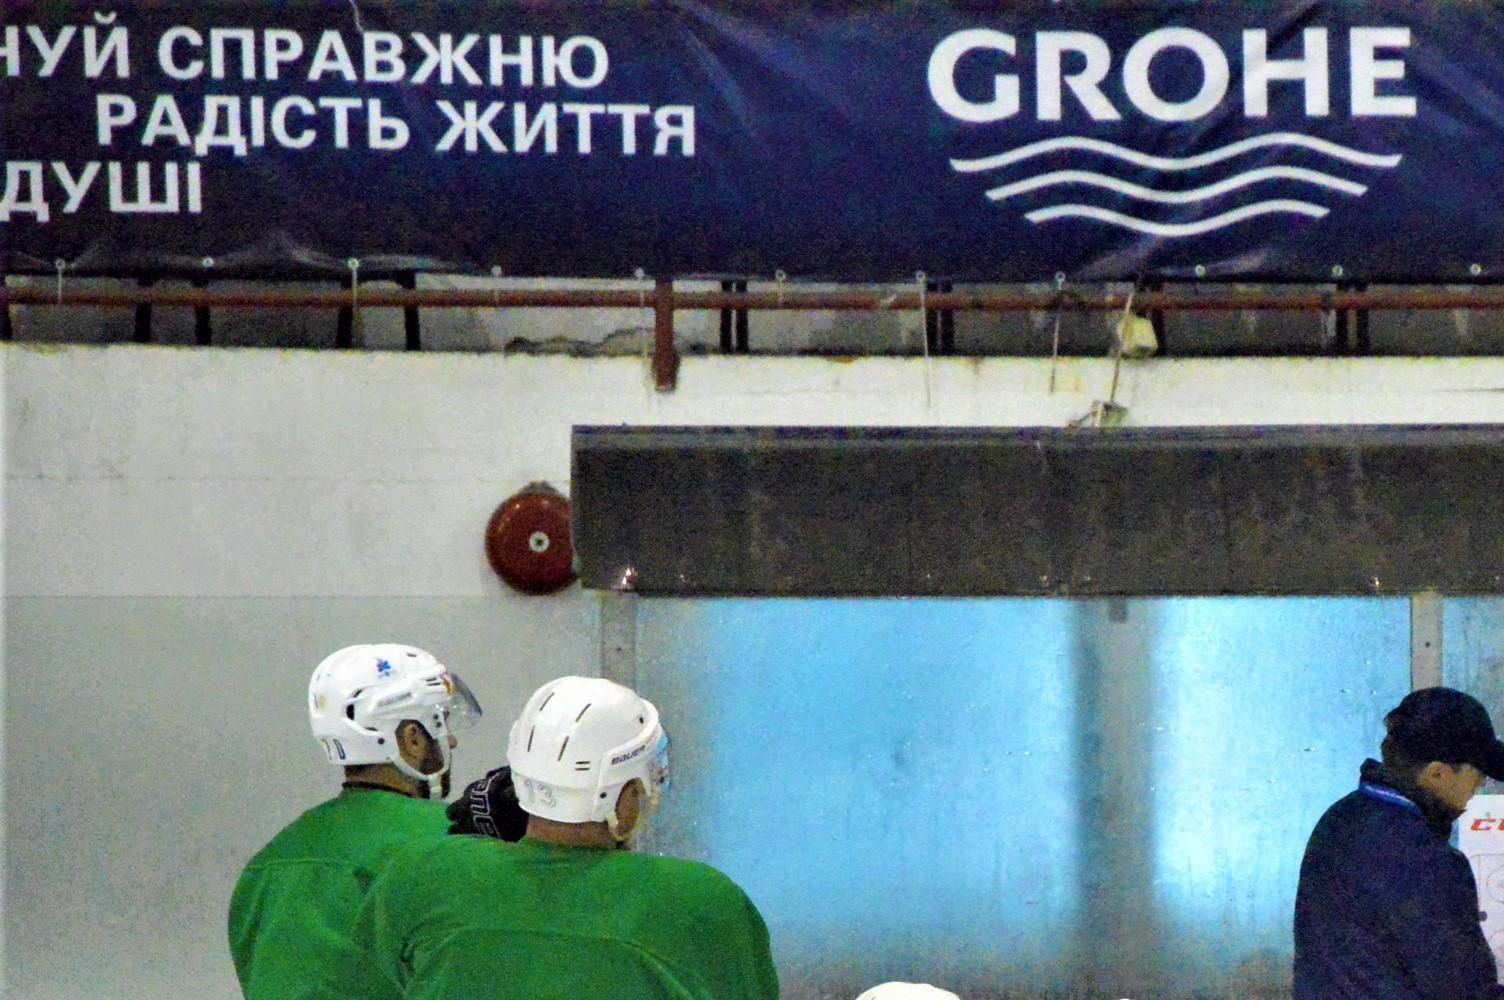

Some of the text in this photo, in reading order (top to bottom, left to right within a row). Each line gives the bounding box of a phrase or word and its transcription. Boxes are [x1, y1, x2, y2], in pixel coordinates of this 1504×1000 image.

[158, 26, 609, 88] СПРАВЖНЮ
[927, 26, 1418, 122] GROHE
[96, 93, 696, 157] РАДІСТЬ ЖИТТЯ
[0, 161, 202, 222] ДУШІ
